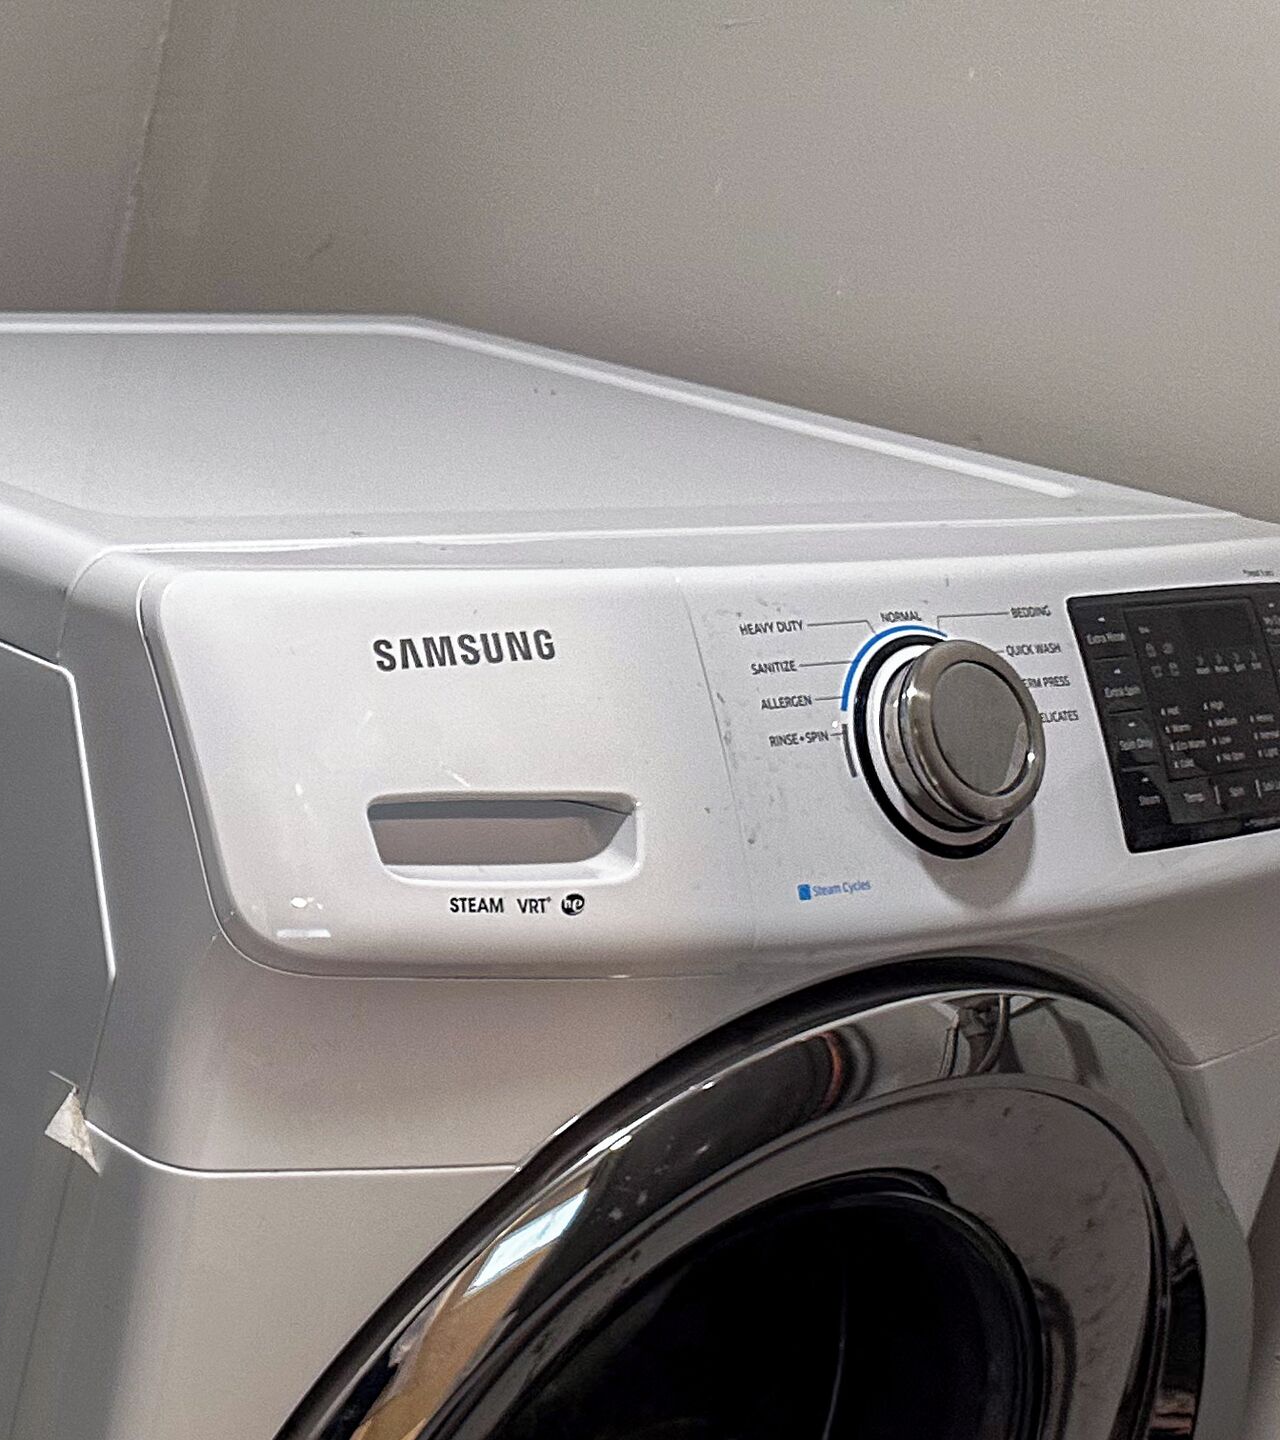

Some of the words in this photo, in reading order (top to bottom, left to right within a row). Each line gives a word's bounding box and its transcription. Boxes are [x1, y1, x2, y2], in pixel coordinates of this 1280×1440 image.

[880, 610, 922, 623] NORMAL
[739, 622, 774, 636] HEAVY
[776, 620, 803, 633] DUTY
[372, 628, 556, 672] SAMSUNG
[1006, 644, 1032, 657] QUICK
[1036, 642, 1061, 654] WASH
[750, 660, 798, 675] SANITIZE
[1042, 675, 1071, 687] PRESS
[760, 695, 813, 710] ALLERGEN
[1039, 710, 1079, 723] ELICATES
[812, 885, 841, 897] Steam
[842, 880, 871, 894] Cycles
[449, 896, 505, 914] STEAM
